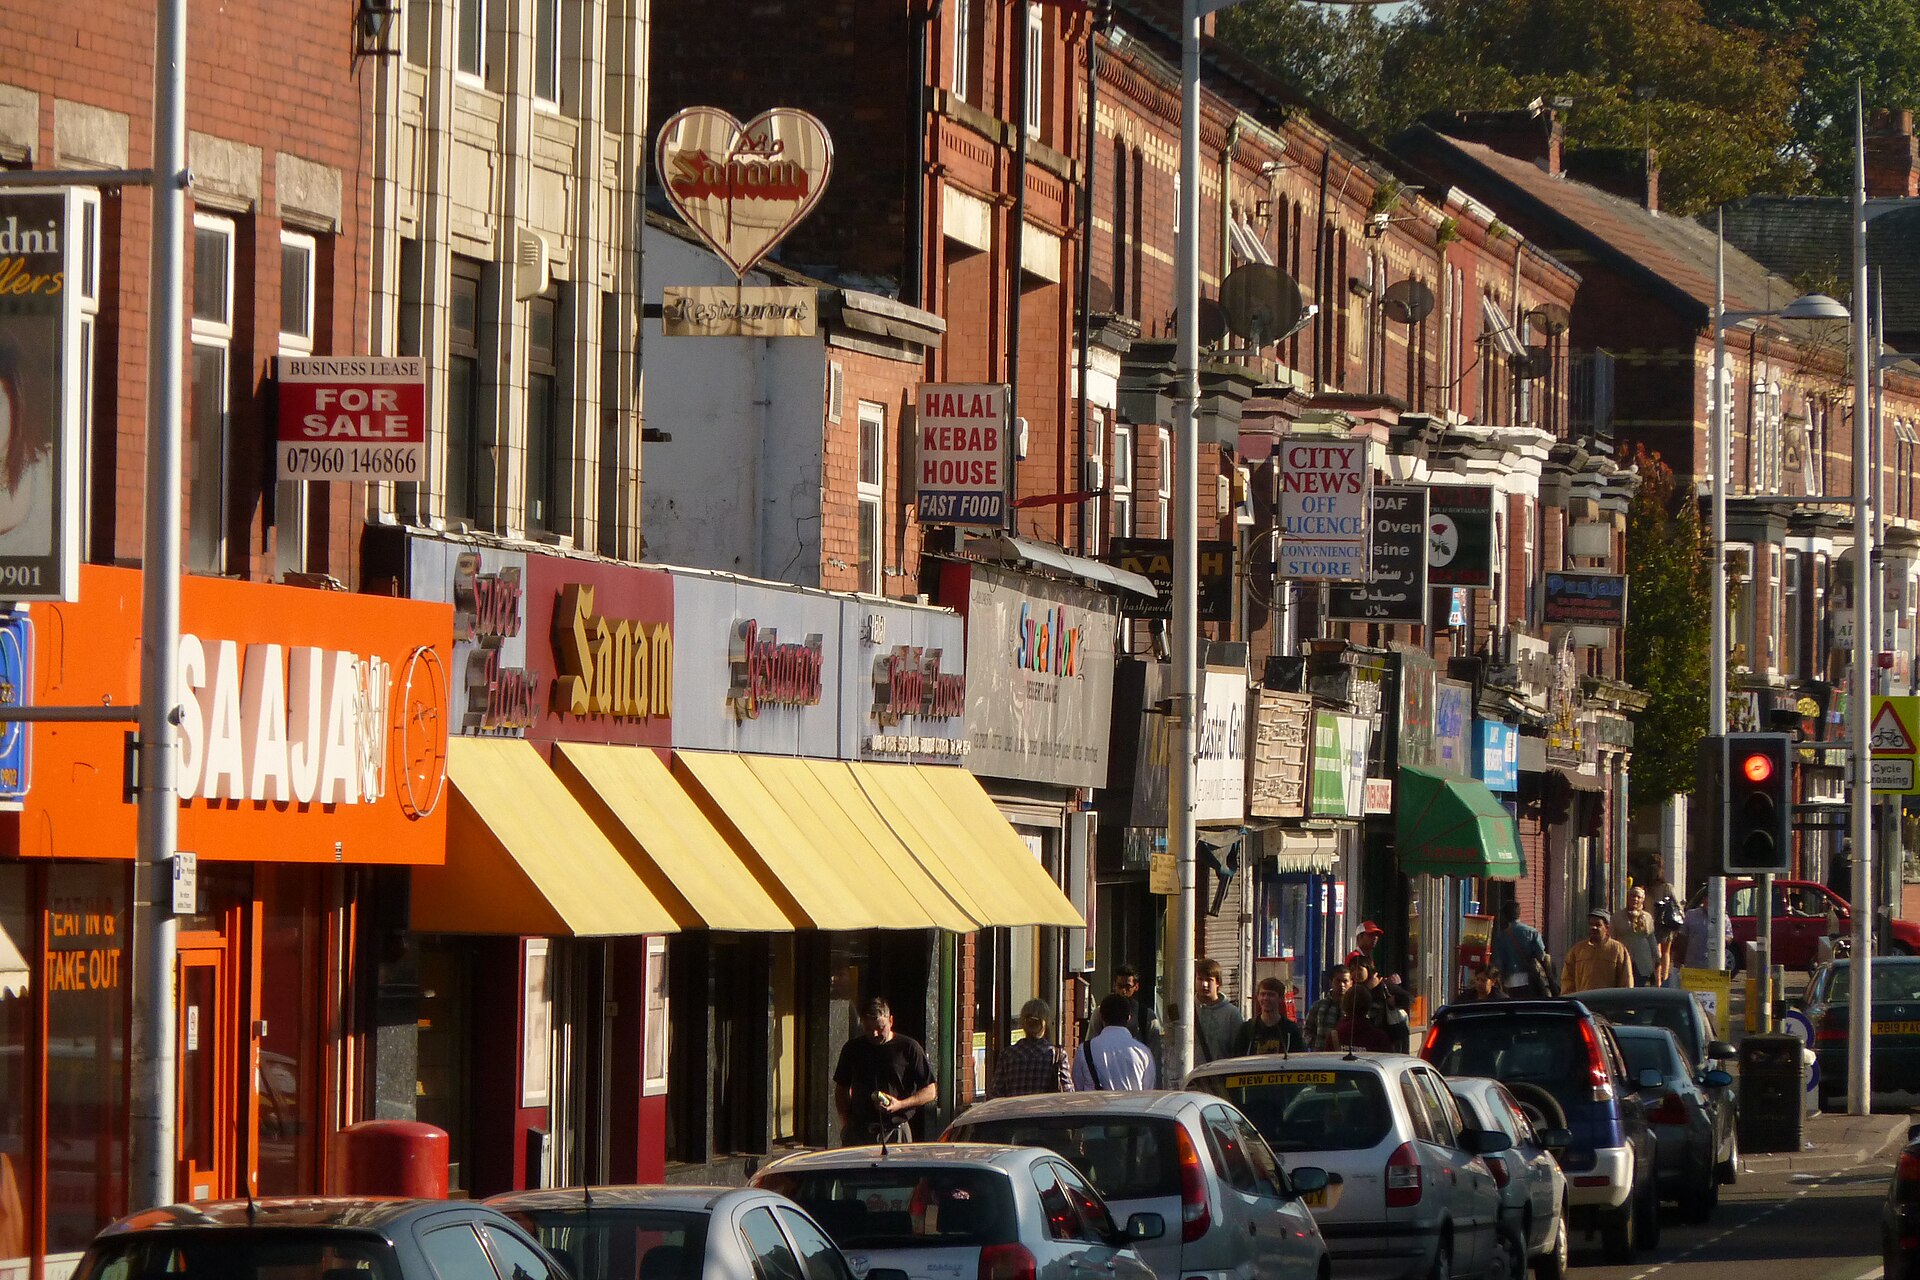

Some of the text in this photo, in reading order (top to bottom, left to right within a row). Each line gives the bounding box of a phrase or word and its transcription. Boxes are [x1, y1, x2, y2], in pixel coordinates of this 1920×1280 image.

[671, 149, 804, 192] Sanam
[290, 361, 419, 376] BUSINESS LEASE
[315, 388, 399, 412] FOR
[925, 393, 997, 418] HALAL
[302, 414, 409, 438] SALE
[923, 427, 997, 452] KEBAB
[287, 447, 416, 474] 07960 146866
[1288, 447, 1355, 469] CITY
[923, 460, 997, 485] HOUSE
[1282, 472, 1361, 494] NEWS
[920, 495, 1000, 517] FAST FOOD
[1302, 496, 1337, 513] OFF
[1287, 516, 1361, 535] LICENCE
[1377, 520, 1421, 533] Oven
[1281, 545, 1361, 557] CONVENIENCE
[1288, 561, 1351, 575] STORE
[1547, 575, 1623, 598] Punjab
[566, 583, 673, 718] Sanam
[178, 634, 391, 805] SAAJAN
[1873, 764, 1901, 774] Cycle
[1871, 776, 1909, 785] rossing
[54, 913, 79, 936] EAT
[85, 913, 100, 935] IN
[48, 949, 120, 990] TAKE OUT
[1239, 1073, 1328, 1085] NEW CITY CARS
